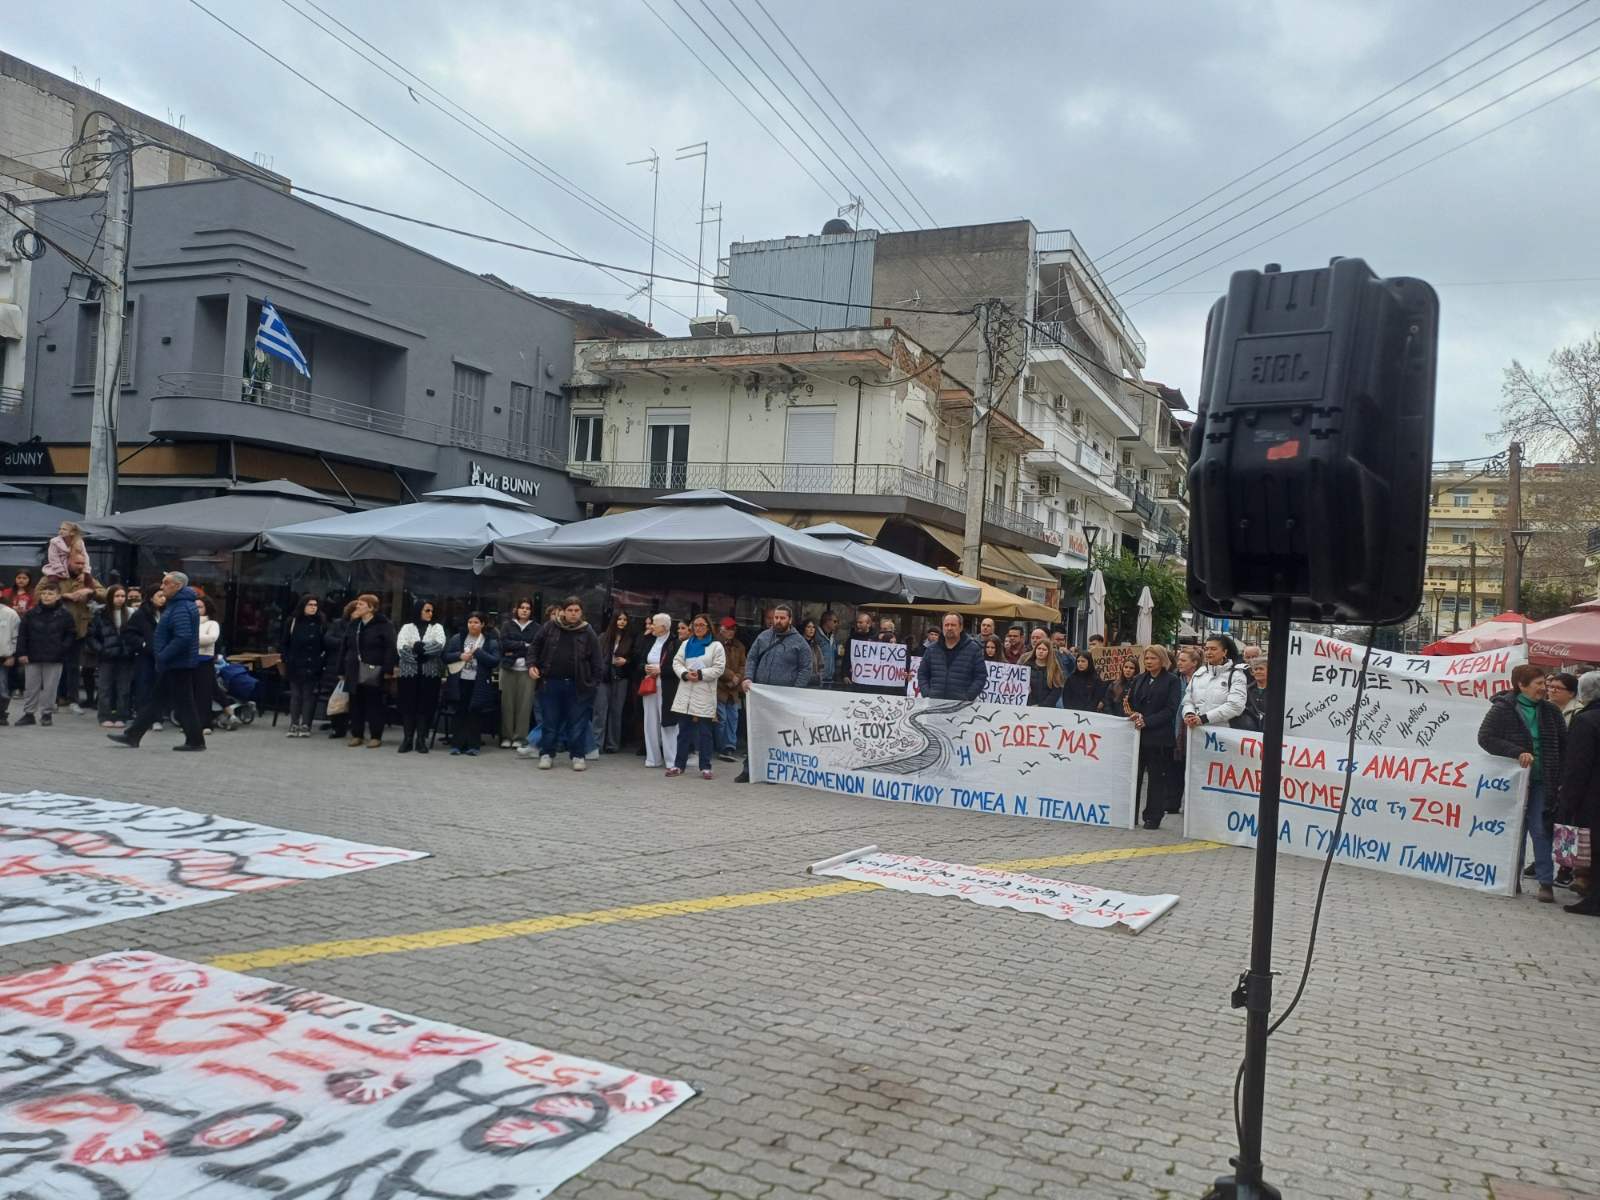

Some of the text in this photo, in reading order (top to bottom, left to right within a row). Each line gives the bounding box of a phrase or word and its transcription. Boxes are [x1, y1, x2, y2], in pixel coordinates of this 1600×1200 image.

[483, 472, 540, 496] Mr BUNNY
[854, 644, 878, 658] ΔΕΝ
[1291, 636, 1301, 655] Η
[1406, 659, 1430, 674] ΤΑ
[1446, 651, 1510, 675] ΚΕΡΔΗ
[1401, 679, 1429, 694] ΤΑ
[1328, 694, 1370, 728] Γάλακος
[778, 722, 896, 748] ΤΑ ΚΕΡΔΗ ΤΟΥΣ
[975, 731, 992, 754] ΟΙ
[1000, 725, 1051, 748] ΖΩΕΣ
[1057, 728, 1102, 760] ΜΑΣ
[768, 748, 818, 768] ΣΩΜΑΤΕΙΟ
[1362, 754, 1469, 788] ΑΝΑΓΚΕΣ
[767, 763, 1111, 824] ΕΡΓΑΖΟΜΕΝΩΝ ΙΔΙΩΤΙΚΟΥ ΤΟΜΕΑ Ν. ΠΕΛΛΑΣ
[1207, 761, 1343, 809] ΠΑΛΕΟΥΜΕ
[1410, 798, 1461, 828] ΖΩΗ
[1227, 811, 1291, 843] ΟΜΑ
[1400, 845, 1497, 885] ΓΙΑΝΝΙΤΣΩΝ
